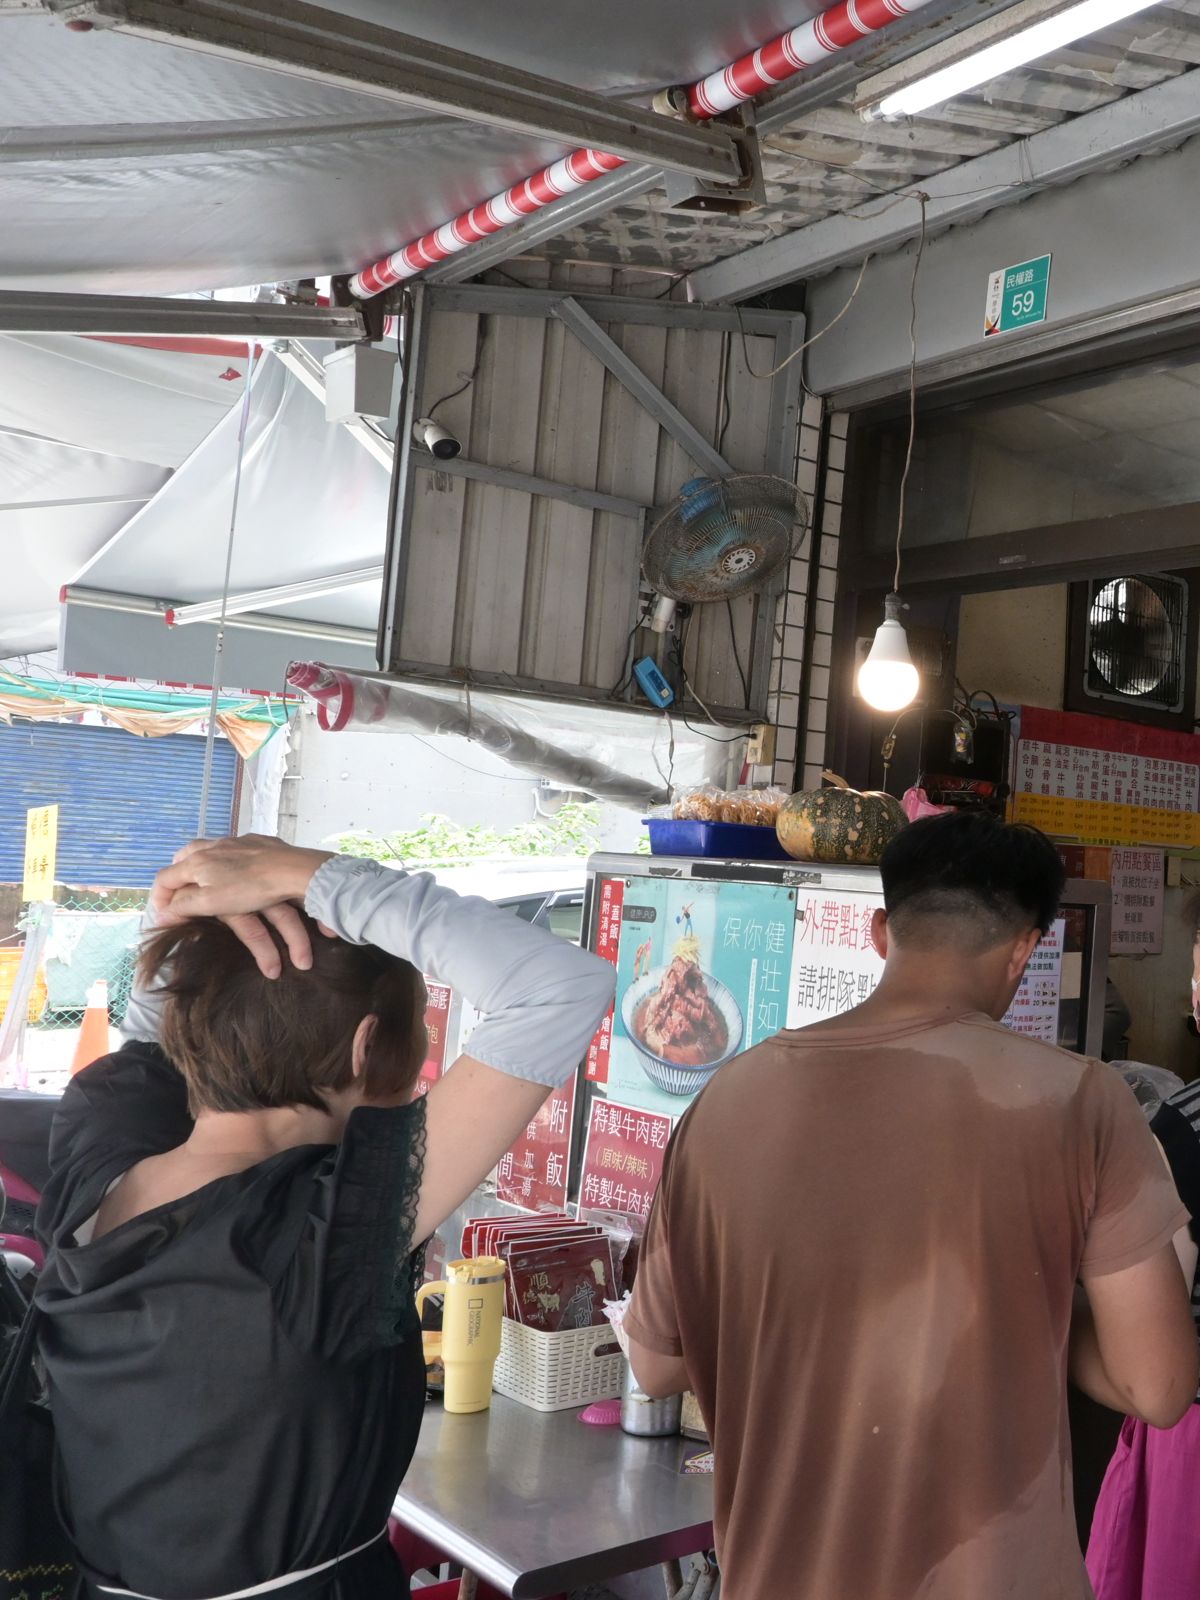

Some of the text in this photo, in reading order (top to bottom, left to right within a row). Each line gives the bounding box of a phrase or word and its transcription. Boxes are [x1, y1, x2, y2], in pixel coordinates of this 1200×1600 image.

[1011, 290, 1035, 316] 59
[800, 898, 877, 951] 外帶點餐
[594, 1104, 668, 1149] 特製牛肉乾
